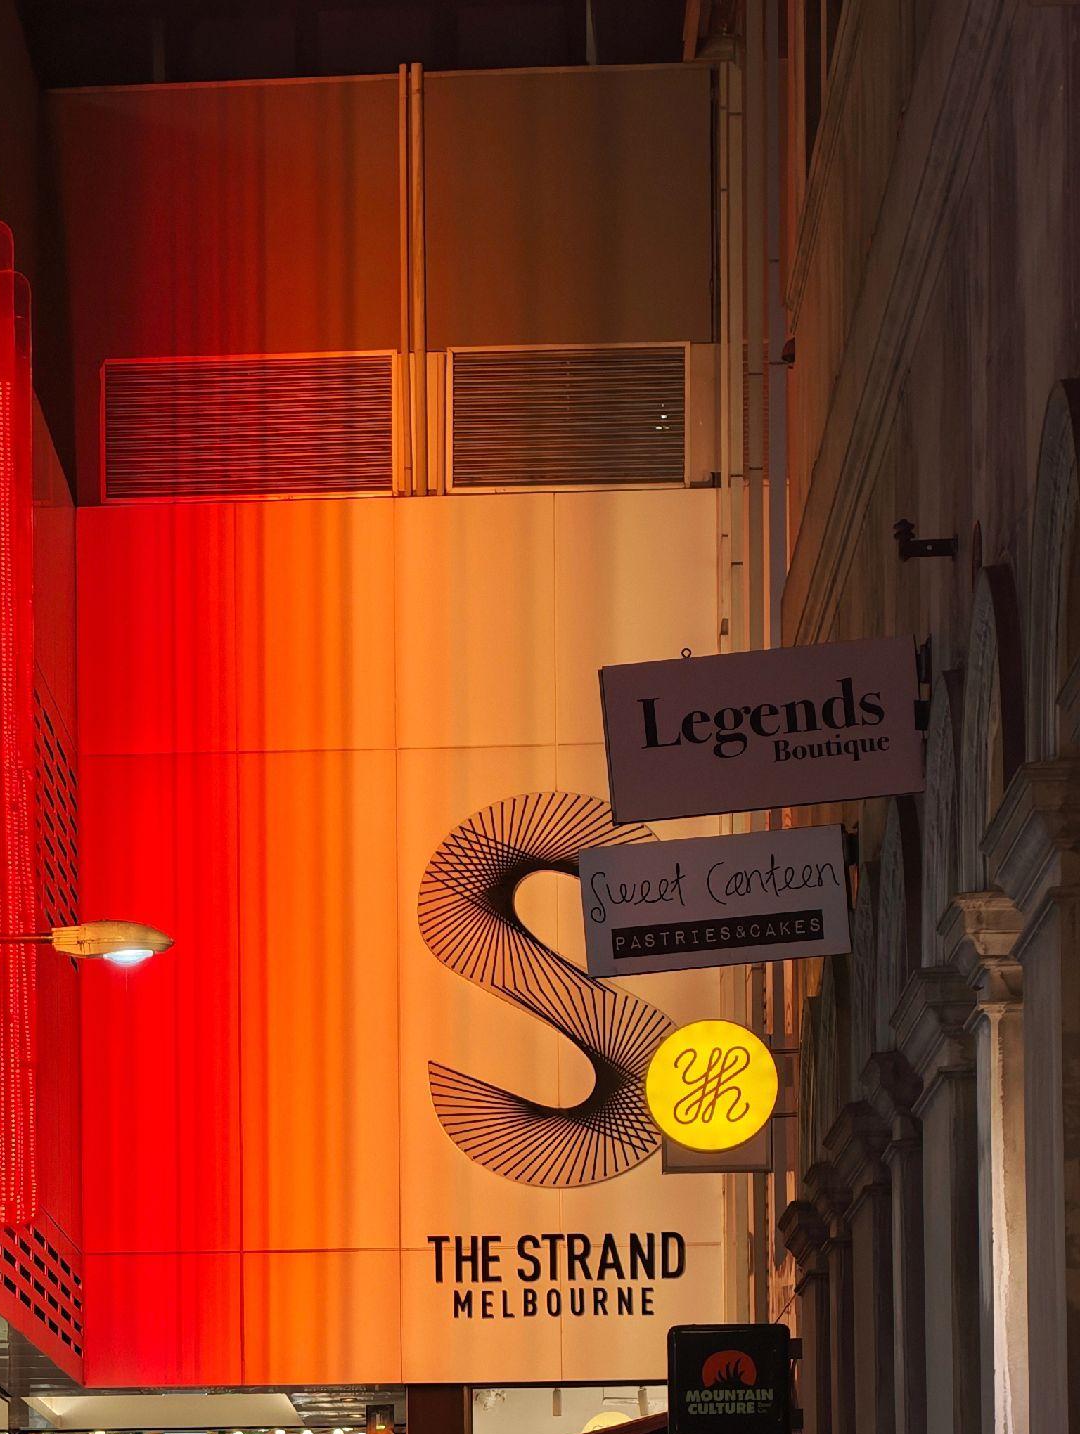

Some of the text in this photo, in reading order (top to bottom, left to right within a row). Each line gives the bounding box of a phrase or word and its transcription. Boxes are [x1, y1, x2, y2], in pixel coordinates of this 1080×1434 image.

[637, 677, 885, 758] Legends
[773, 734, 890, 762] Boutique
[590, 853, 840, 923] Sweet Canteen
[427, 1232, 687, 1283] THE STRAND
[453, 1287, 655, 1319] MELBOURNE
[685, 1388, 774, 1403] MOUNTAIN
[688, 1402, 755, 1415] CULTURE
